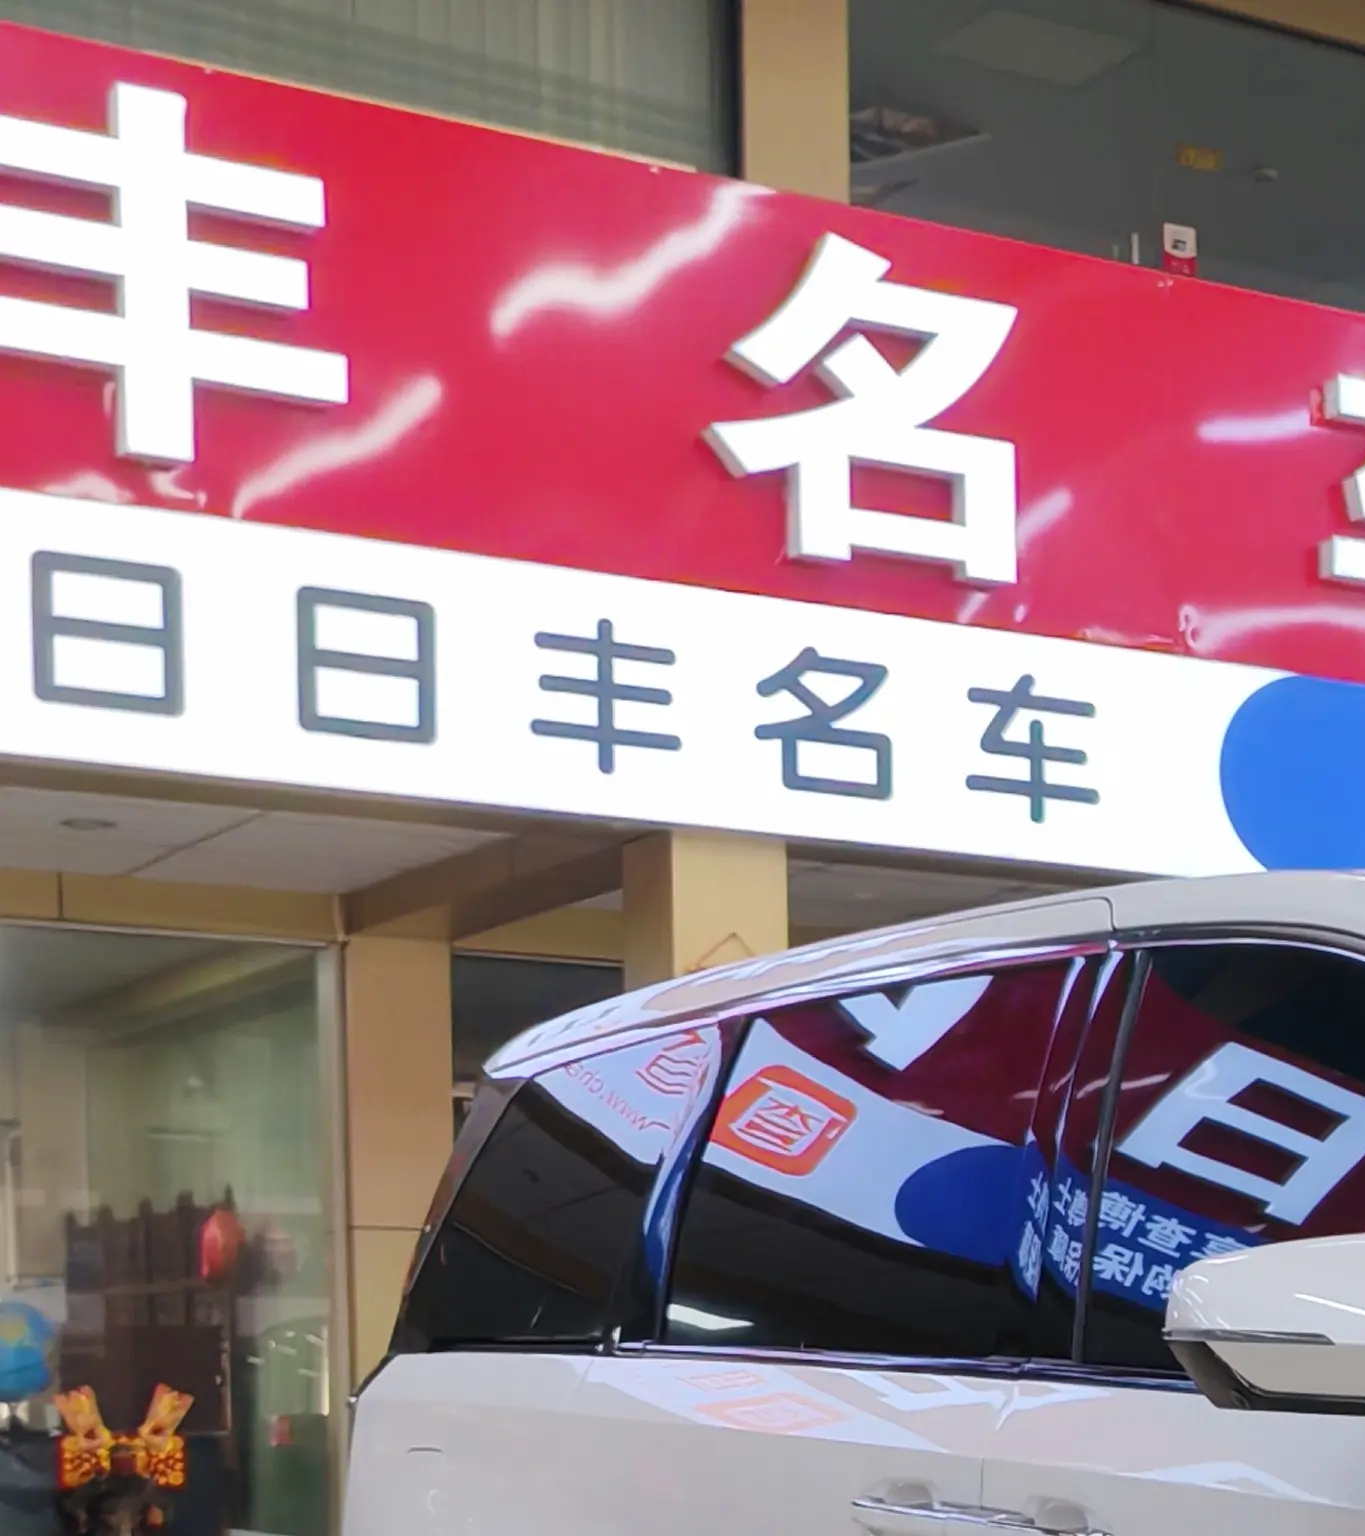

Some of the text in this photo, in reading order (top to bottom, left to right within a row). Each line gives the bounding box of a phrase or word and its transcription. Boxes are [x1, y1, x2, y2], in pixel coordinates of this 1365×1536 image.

[31, 549, 1100, 824] 日日丰名车
